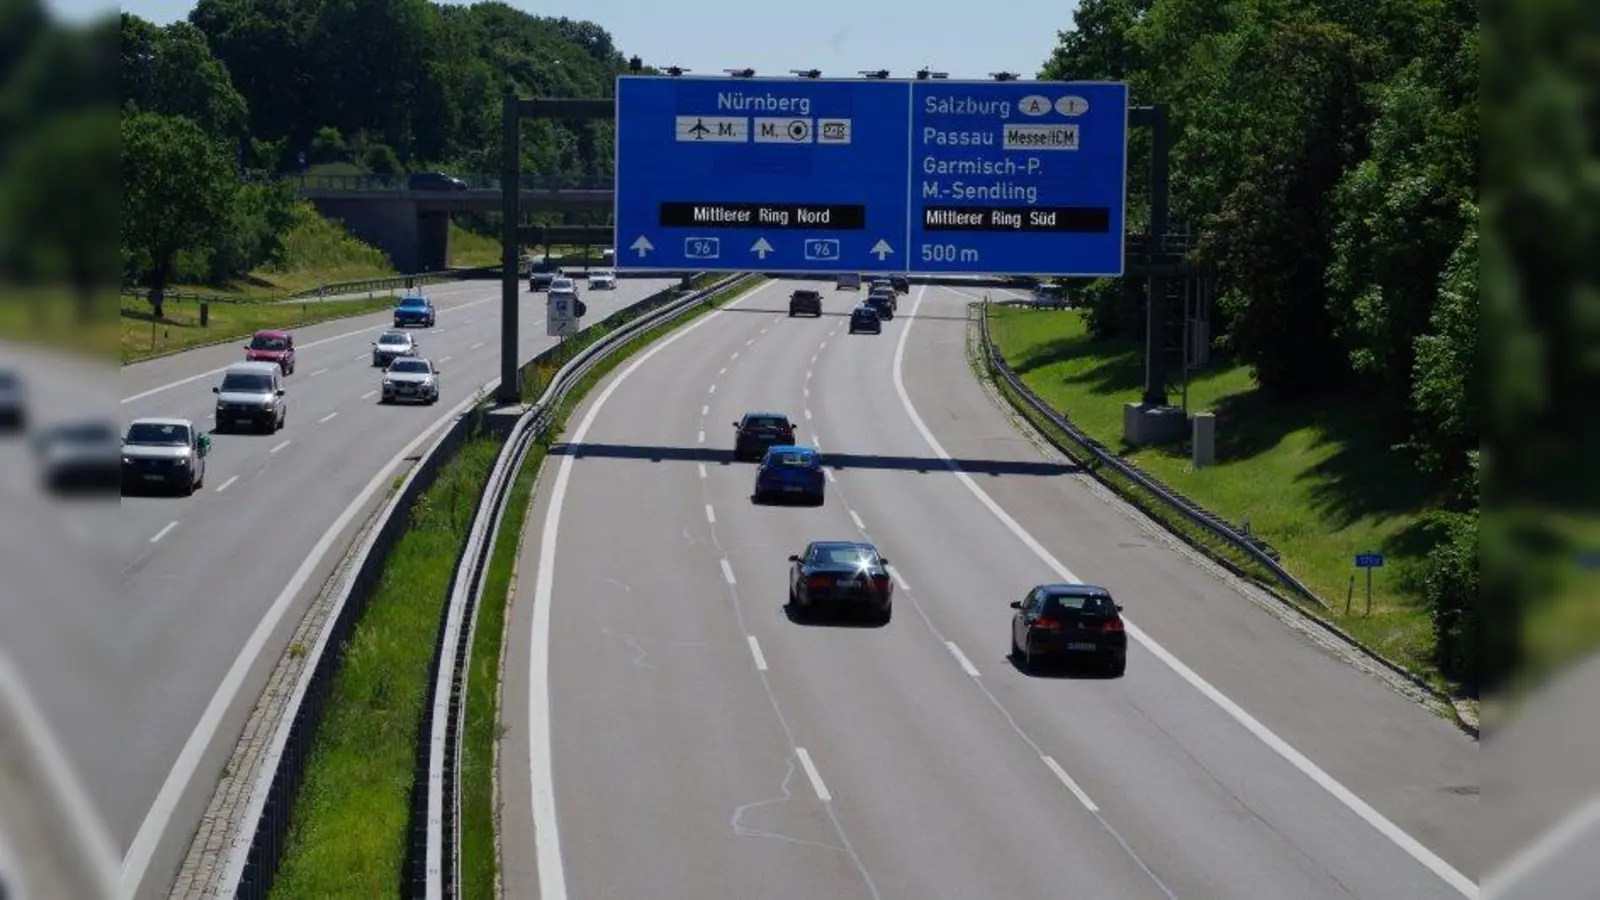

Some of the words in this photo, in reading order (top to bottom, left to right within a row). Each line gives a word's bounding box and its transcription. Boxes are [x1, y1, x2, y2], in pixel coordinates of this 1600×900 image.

[717, 92, 810, 114] Nürnberg
[925, 96, 1011, 118] Salzburg
[1029, 100, 1041, 113] A
[718, 122, 736, 137] M.
[761, 123, 779, 138] M.
[923, 127, 993, 145] Passau
[1007, 131, 1074, 145] Messe/ICM
[923, 157, 1043, 175] Garmisch-P.
[922, 181, 1037, 203] M.-Sendling
[693, 206, 750, 222] Mittlerer
[759, 207, 789, 225] Ring
[797, 208, 830, 224] Nord
[926, 210, 983, 226] Mittlerer
[991, 211, 1021, 228] Ring
[1030, 211, 1056, 226] Süd
[693, 241, 711, 255] 96
[814, 243, 830, 256] 96
[921, 245, 956, 262] 500
[960, 247, 978, 262] m
